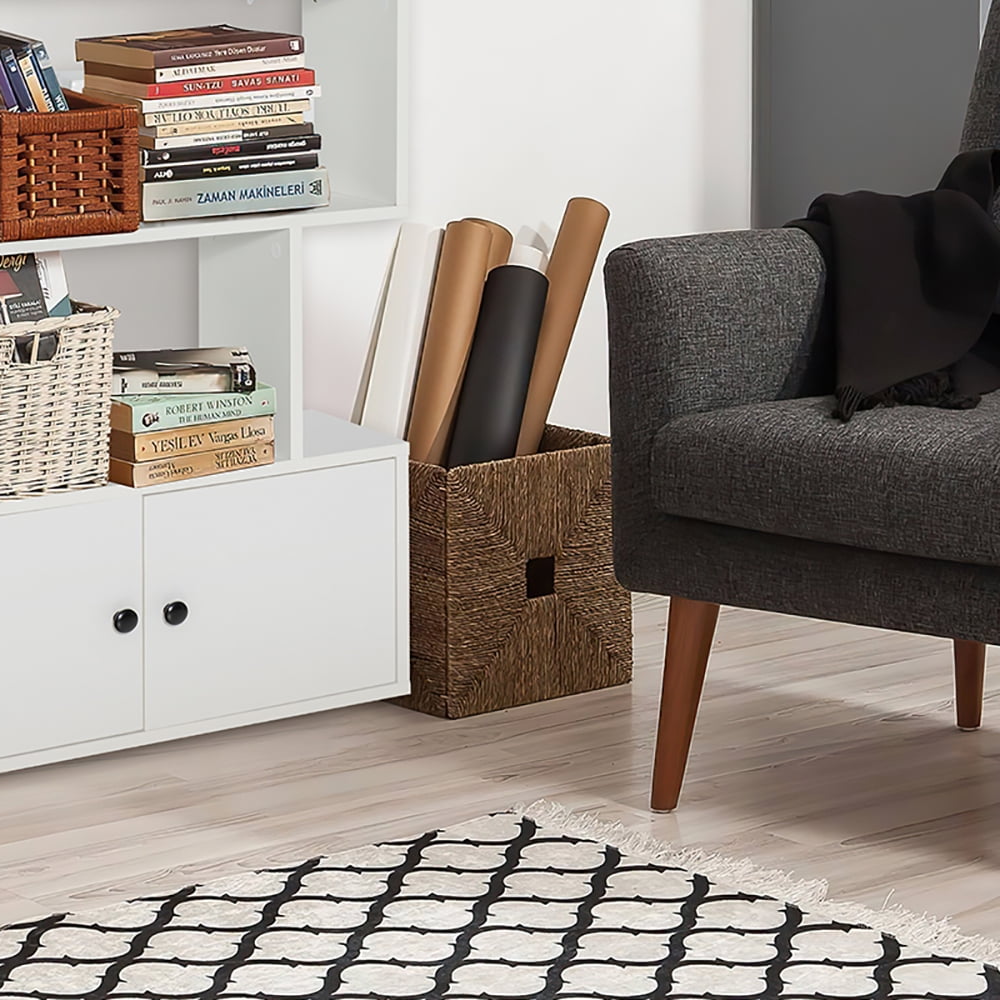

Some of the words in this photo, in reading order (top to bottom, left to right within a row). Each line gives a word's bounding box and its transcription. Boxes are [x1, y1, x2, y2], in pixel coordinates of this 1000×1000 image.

[183, 81, 224, 93] SUN-TZU
[197, 189, 236, 204] ZAMAN
[165, 401, 203, 417] ROBERT
[206, 395, 253, 410] WINSTON
[178, 415, 192, 424] THE
[222, 409, 242, 419] MIND
[208, 429, 239, 445] Vargas
[240, 426, 266, 440] Llosa
